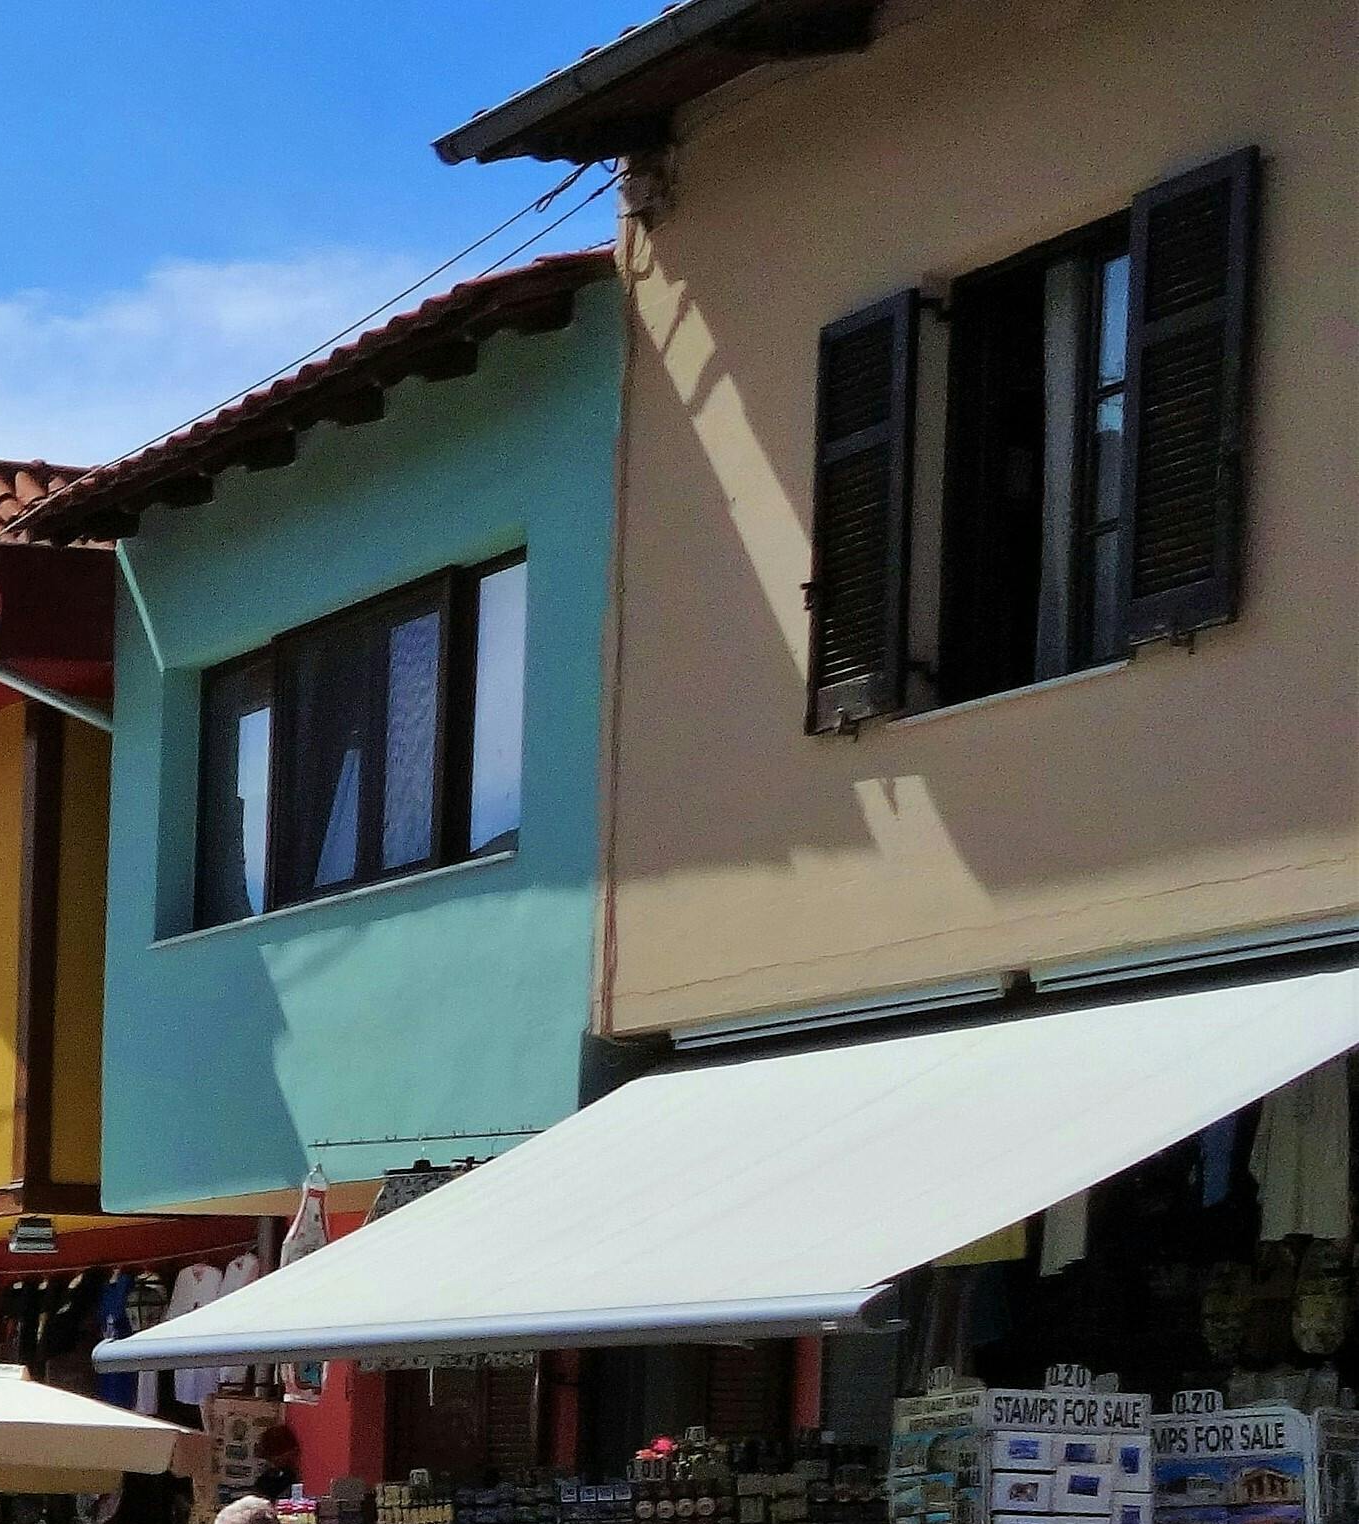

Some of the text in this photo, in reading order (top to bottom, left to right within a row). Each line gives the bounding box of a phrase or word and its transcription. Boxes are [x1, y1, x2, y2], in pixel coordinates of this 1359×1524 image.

[993, 1395, 1058, 1425] STAMPS
[1063, 1398, 1098, 1427] FOR
[1102, 1400, 1142, 1428] SALE
[1150, 1421, 1286, 1454] MPS FOR SALE
